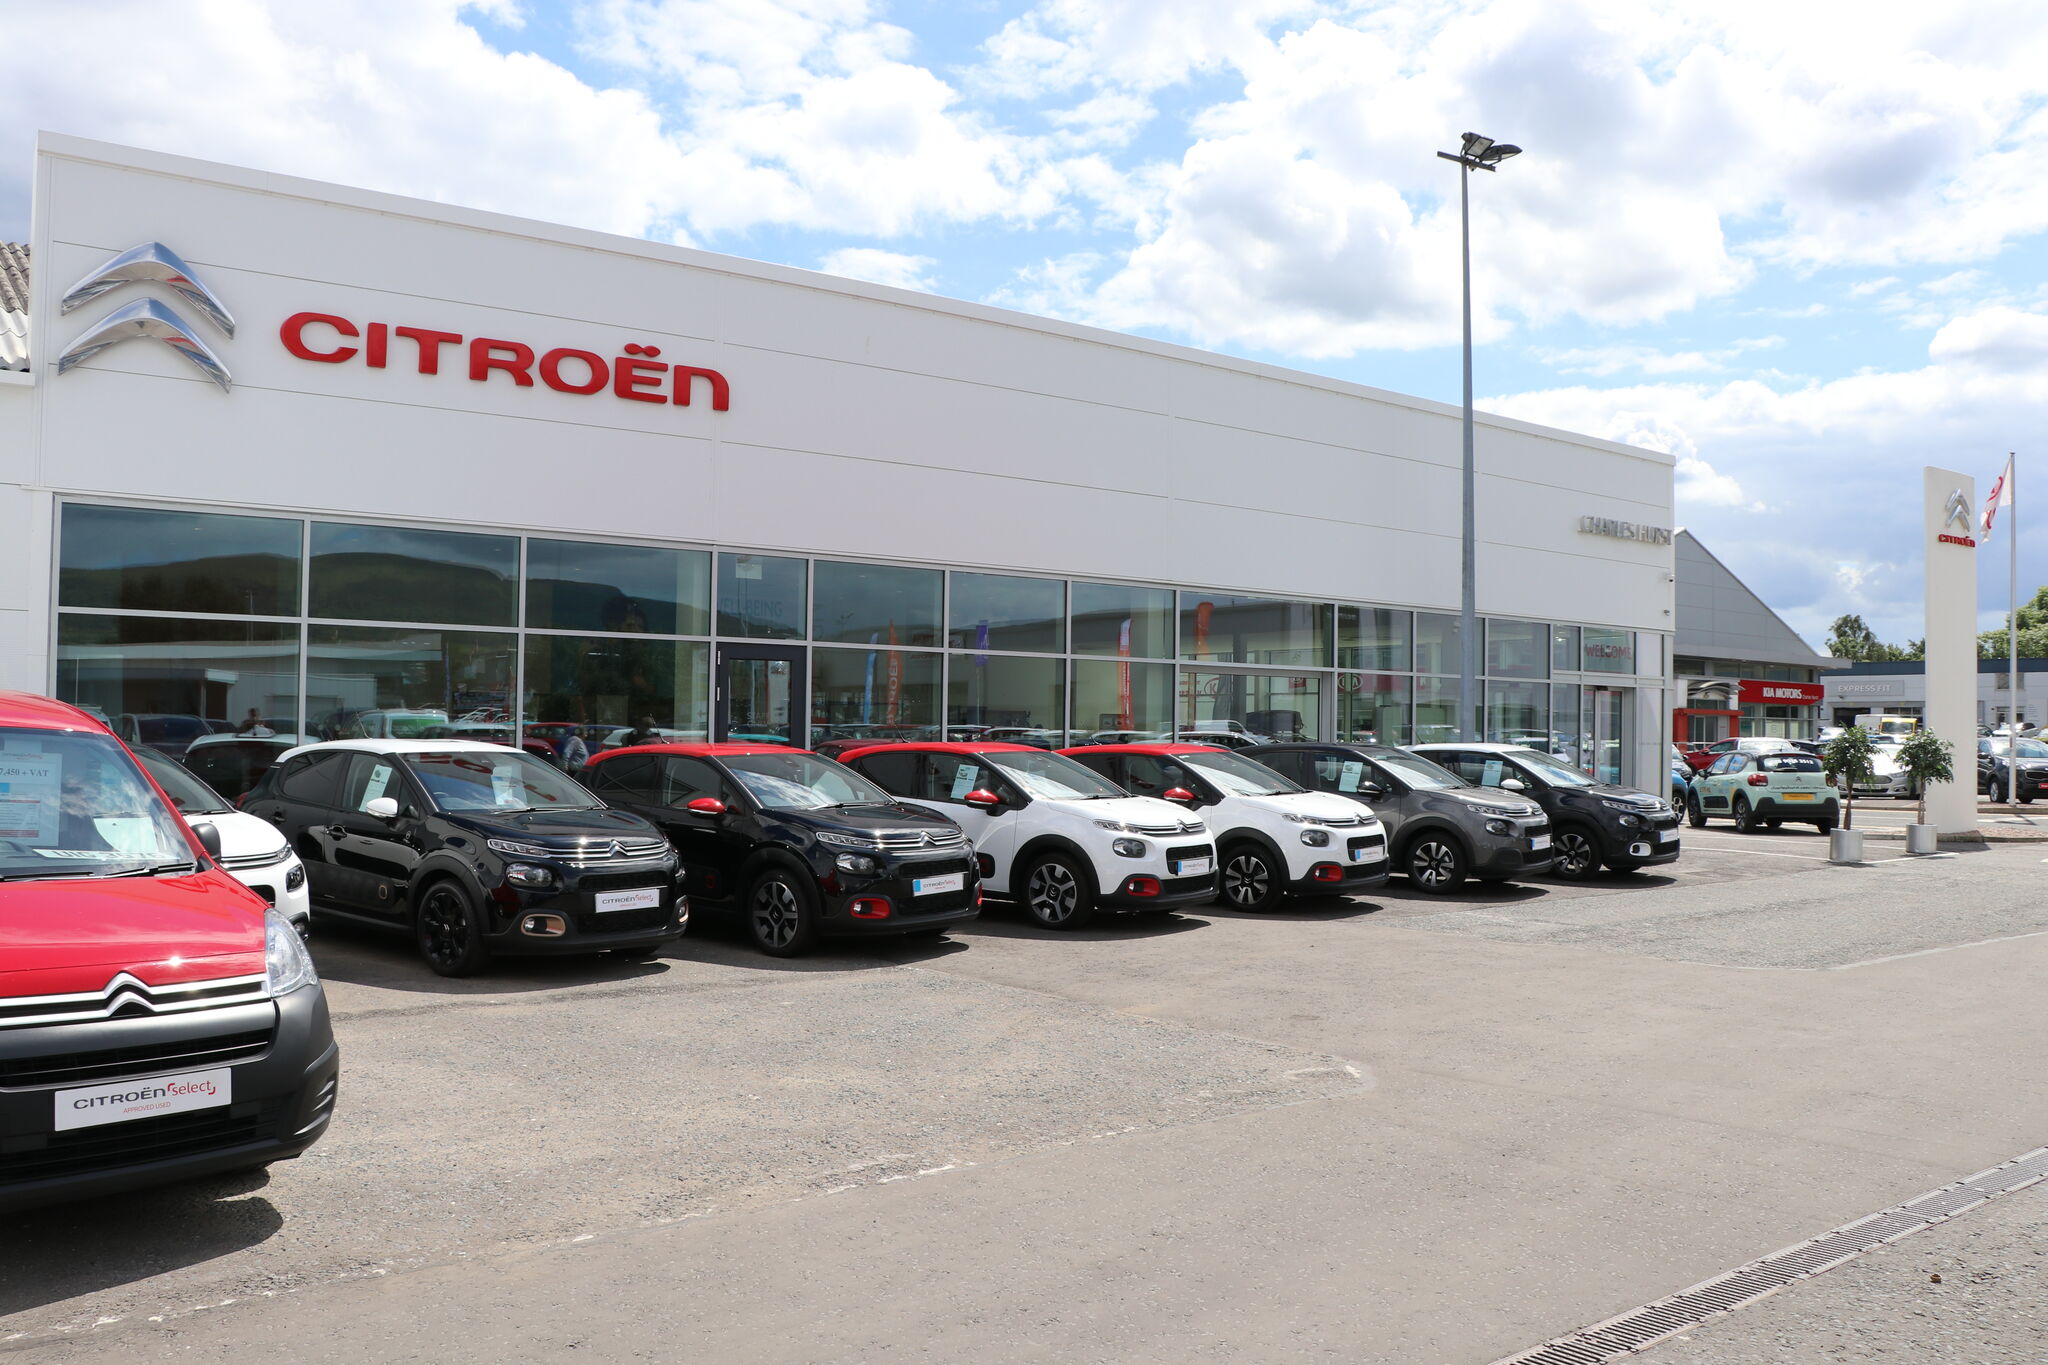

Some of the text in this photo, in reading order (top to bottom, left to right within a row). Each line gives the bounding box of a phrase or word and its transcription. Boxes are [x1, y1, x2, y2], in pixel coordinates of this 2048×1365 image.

[280, 311, 730, 412] CITROËN
[1577, 515, 1672, 546] CHARLES HURST
[1938, 534, 1976, 548] CITROËN
[1585, 643, 1633, 660] WELCOME
[1763, 687, 1775, 698] KIA
[1776, 688, 1802, 700] MOTORS
[1838, 684, 1891, 692] EXPRESS FIT
[30, 768, 49, 777] VAT
[602, 896, 635, 904] CITROËN
[73, 1086, 166, 1110] CITROËN
[123, 1101, 171, 1114] APPROVED USED
